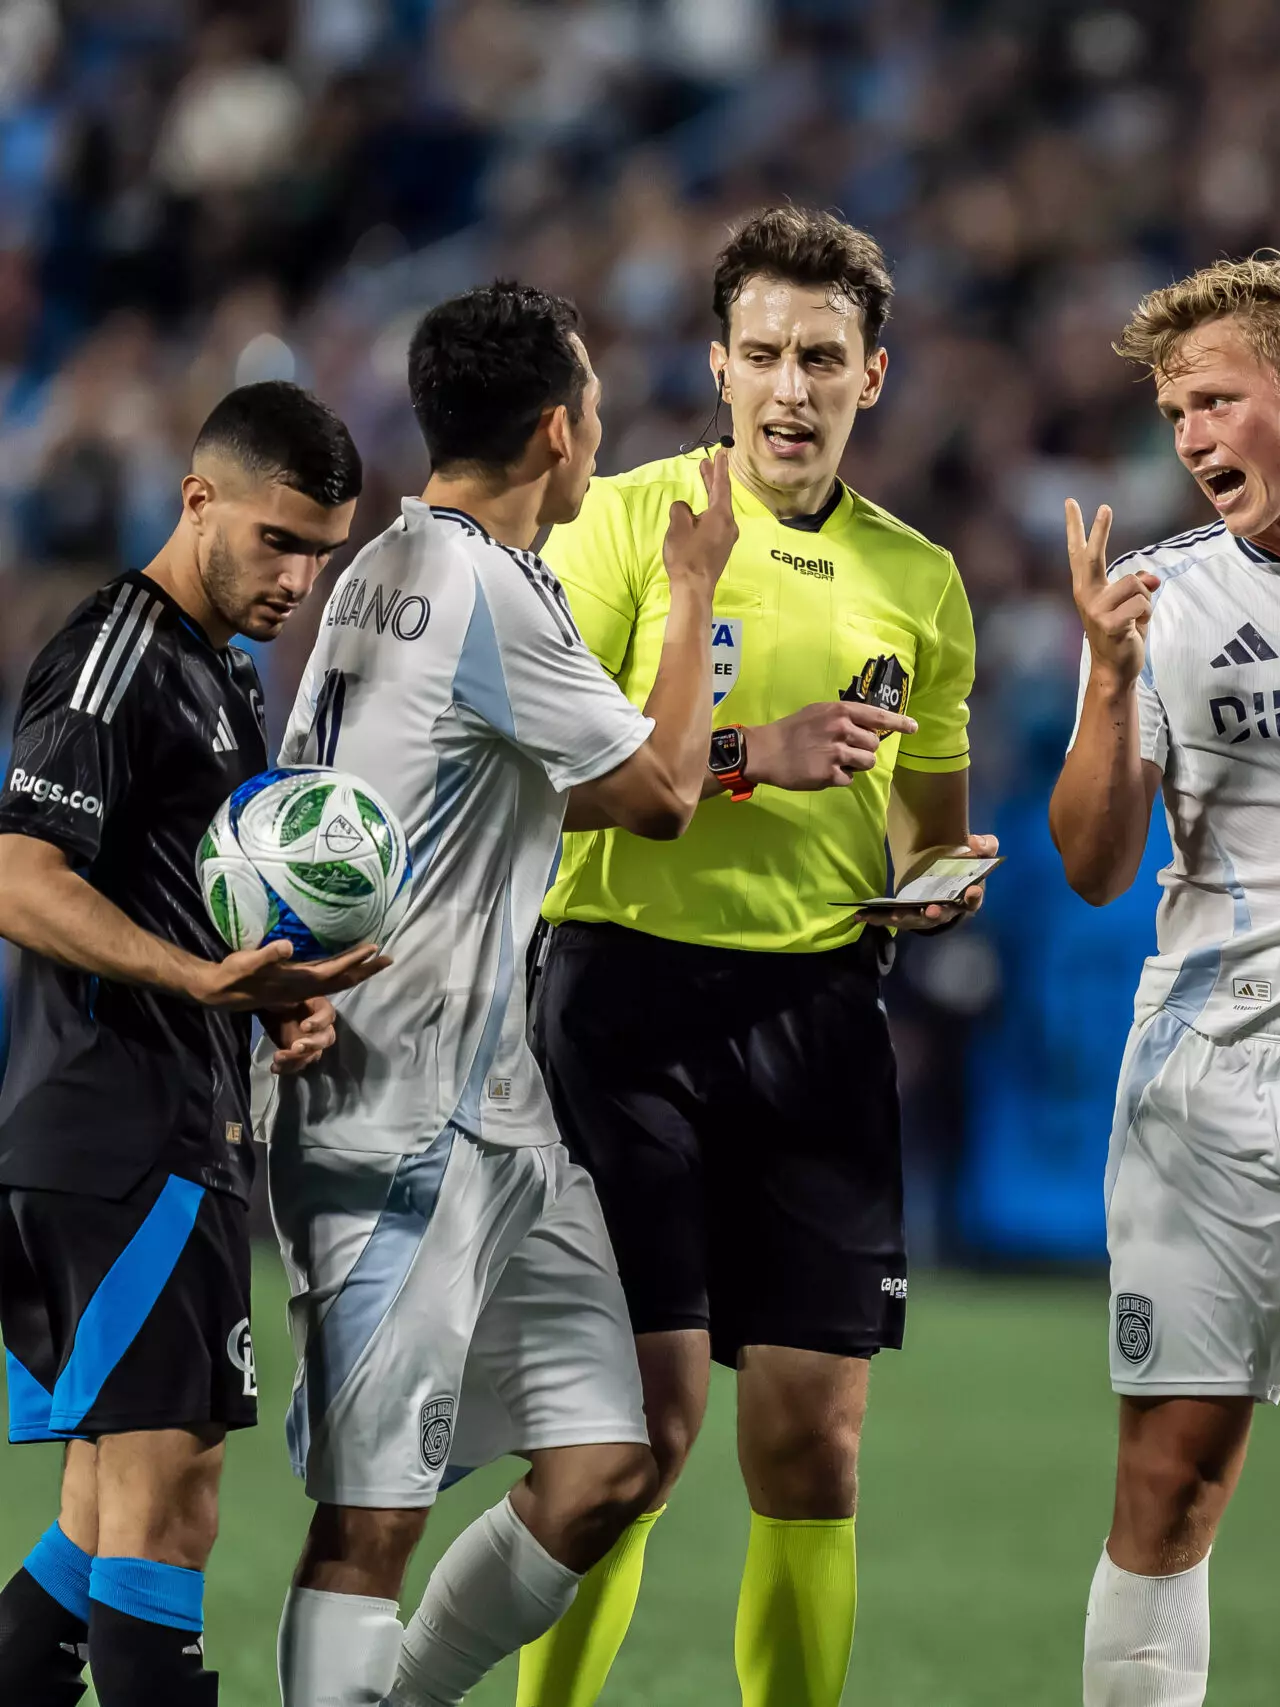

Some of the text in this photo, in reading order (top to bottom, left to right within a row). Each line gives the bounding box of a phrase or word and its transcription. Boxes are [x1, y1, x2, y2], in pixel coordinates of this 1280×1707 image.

[770, 549, 835, 577] capelli
[800, 568, 835, 582] SPORT
[9, 767, 104, 821] Rugs.co
[881, 1277, 908, 1296] cape
[1130, 1298, 1149, 1315] DIEGO
